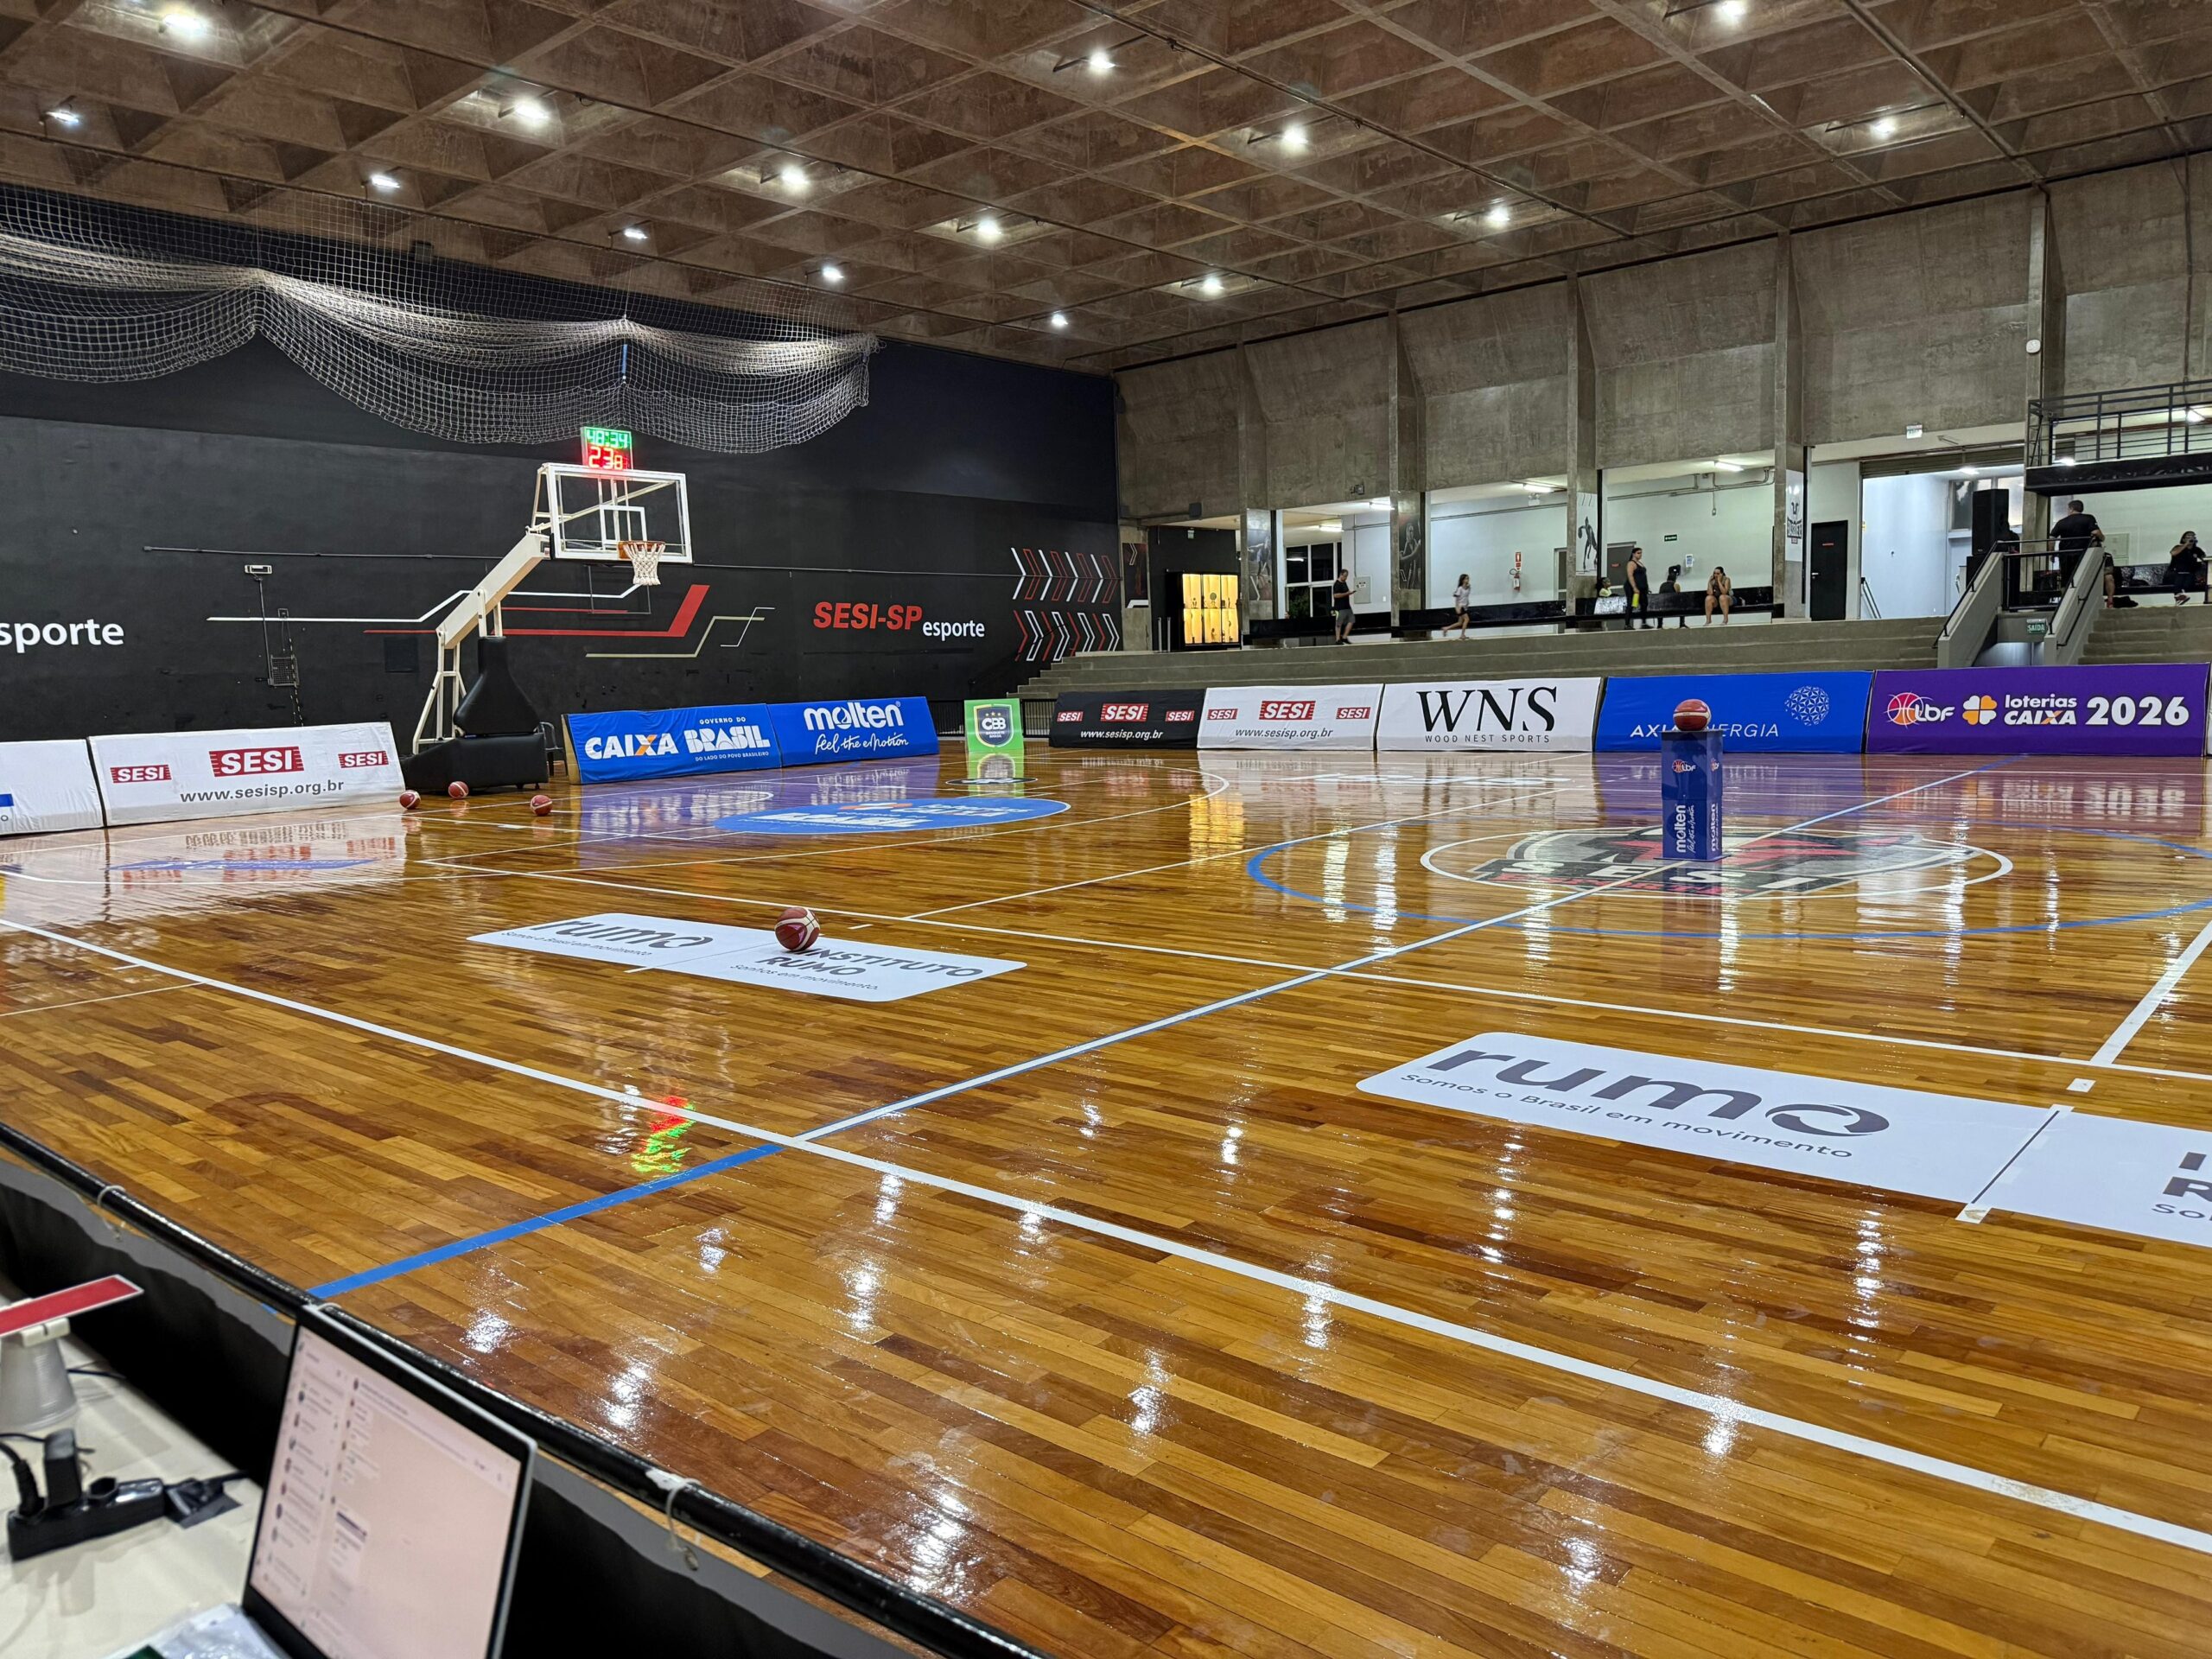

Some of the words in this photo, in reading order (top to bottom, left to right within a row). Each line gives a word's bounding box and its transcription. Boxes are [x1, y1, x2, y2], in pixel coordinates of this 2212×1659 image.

[813, 602, 923, 631] SESI-SP
[922, 619, 985, 641] esporte
[1416, 686, 1557, 732] WNS
[2005, 693, 2077, 709] loterias
[804, 702, 904, 730] molten
[1059, 713, 1081, 721] SESI
[1104, 705, 1143, 721] SESI
[1168, 712, 1192, 721] SESI
[1210, 710, 1236, 719] SESI
[1264, 702, 1311, 719] SESI
[1338, 709, 1367, 719] SESI
[2004, 710, 2076, 726] CAIXA
[2085, 696, 2190, 726] 2026
[982, 717, 1007, 730] CBB
[1706, 723, 1779, 737] ERGIA
[1080, 729, 1164, 741] www.sesisp.org.br
[1235, 728, 1333, 739] www.sesisp.org.br
[1502, 734, 1549, 743] SPORTS
[585, 733, 679, 760] CAIXA
[683, 725, 771, 753] BRASIL
[841, 735, 861, 750] the
[221, 748, 294, 775] SESI
[344, 752, 383, 766] SESI
[118, 766, 165, 781] SESI
[181, 779, 344, 803] www.sesisp.org.br
[1675, 804, 1686, 853] molten
[1501, 861, 1820, 889] SESI
[530, 920, 714, 949] rumo
[754, 957, 867, 976] RUMO
[1426, 1049, 1890, 1138] rumo
[1401, 1073, 1487, 1096] Somos
[1496, 1090, 1513, 1099] o
[1520, 1094, 1600, 1116] Brasil
[1606, 1110, 1652, 1125] em
[1662, 1121, 1853, 1159] movimento
[2152, 1204, 2212, 1221] So
